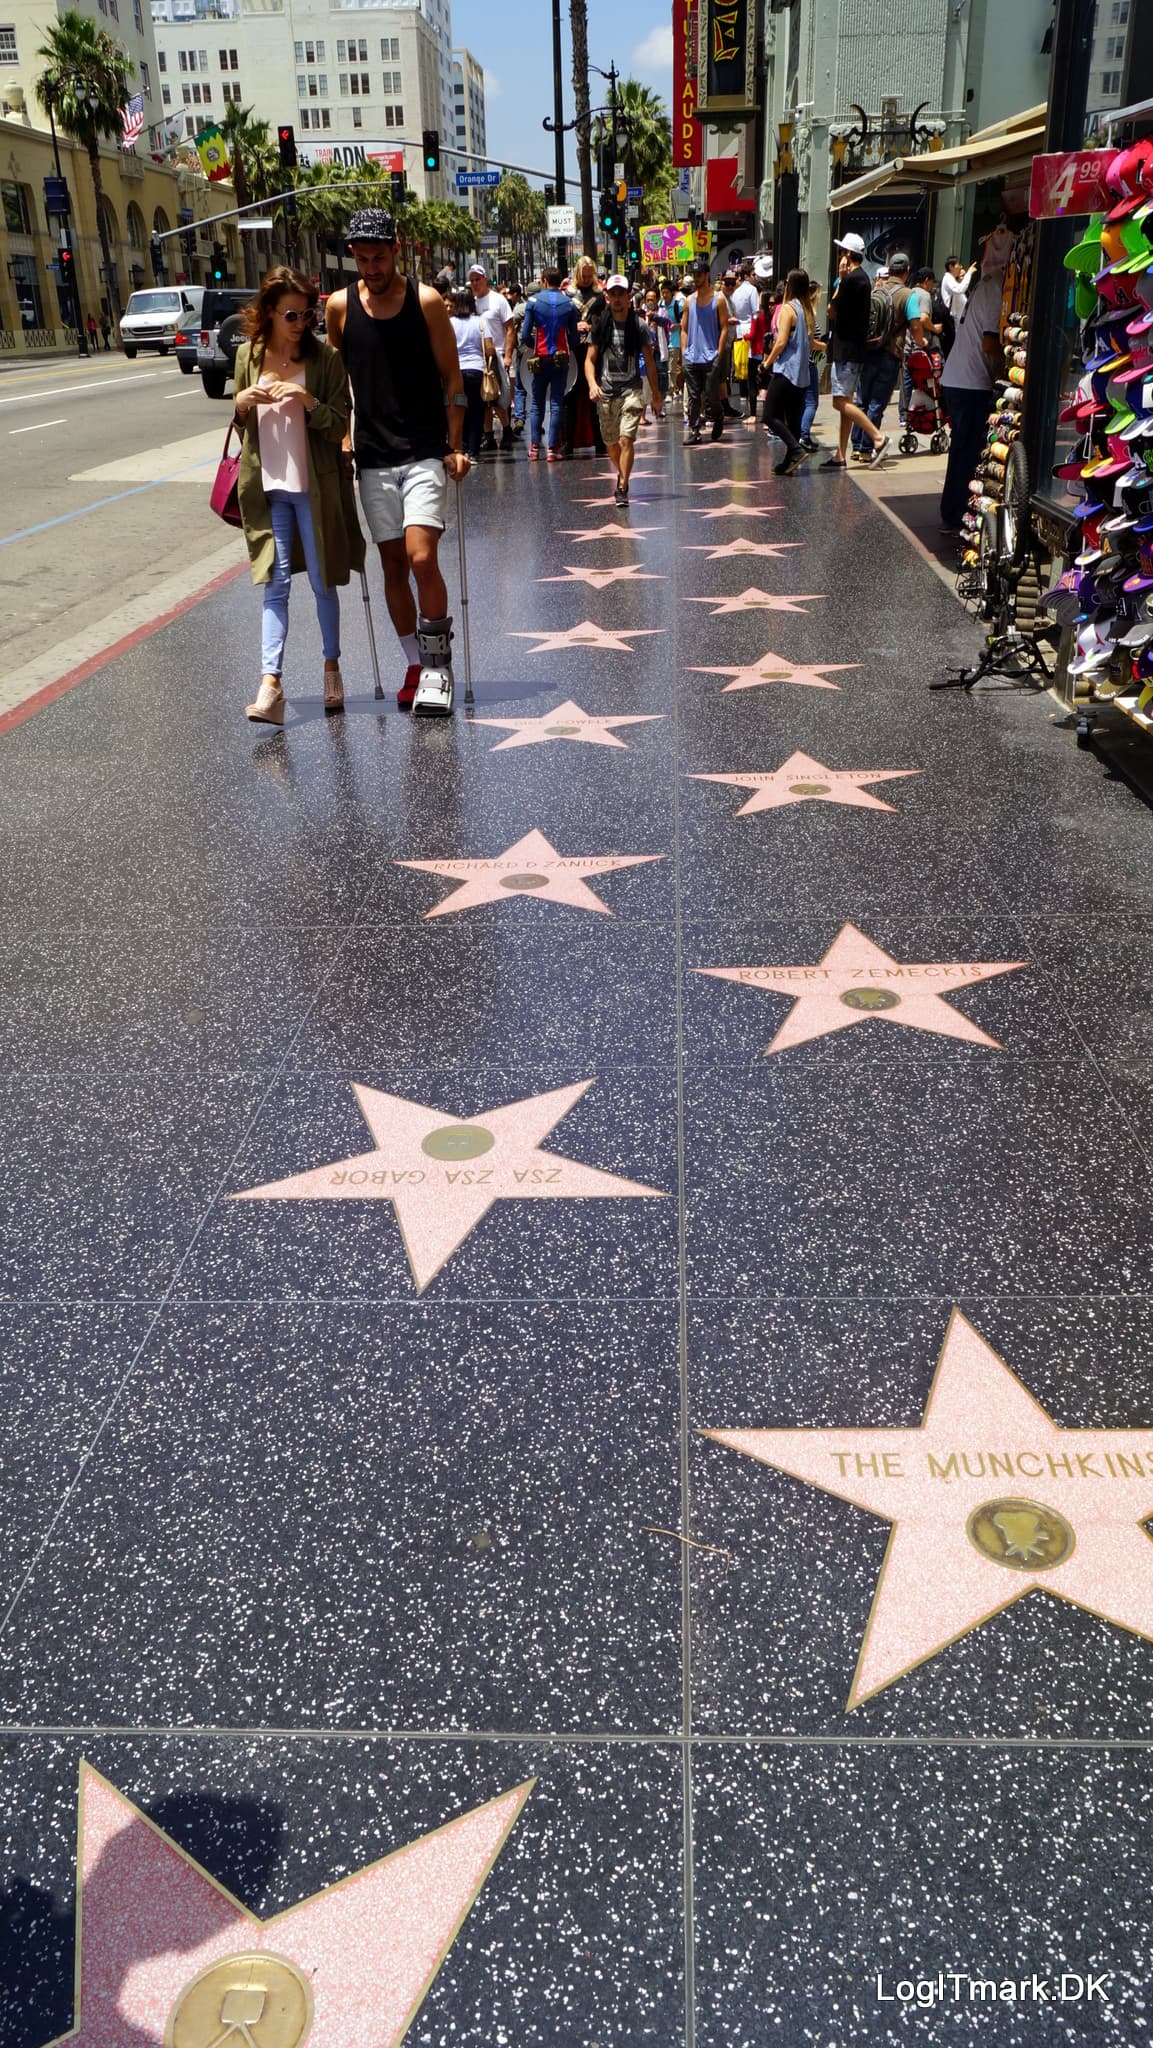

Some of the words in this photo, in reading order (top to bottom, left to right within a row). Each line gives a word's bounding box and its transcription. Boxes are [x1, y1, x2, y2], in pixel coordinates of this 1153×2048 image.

[460, 175, 484, 184] Orange
[786, 773, 881, 781] SINGLETON
[433, 862, 518, 870] RICHARD
[544, 860, 624, 868] ZANUCK
[739, 969, 833, 980] ROBERT
[851, 967, 983, 978] ZEMECKIS
[329, 1169, 426, 1185] GABOR
[444, 1169, 494, 1185] ZSA
[513, 1168, 563, 1184] ZSA
[830, 1452, 905, 1478] THE
